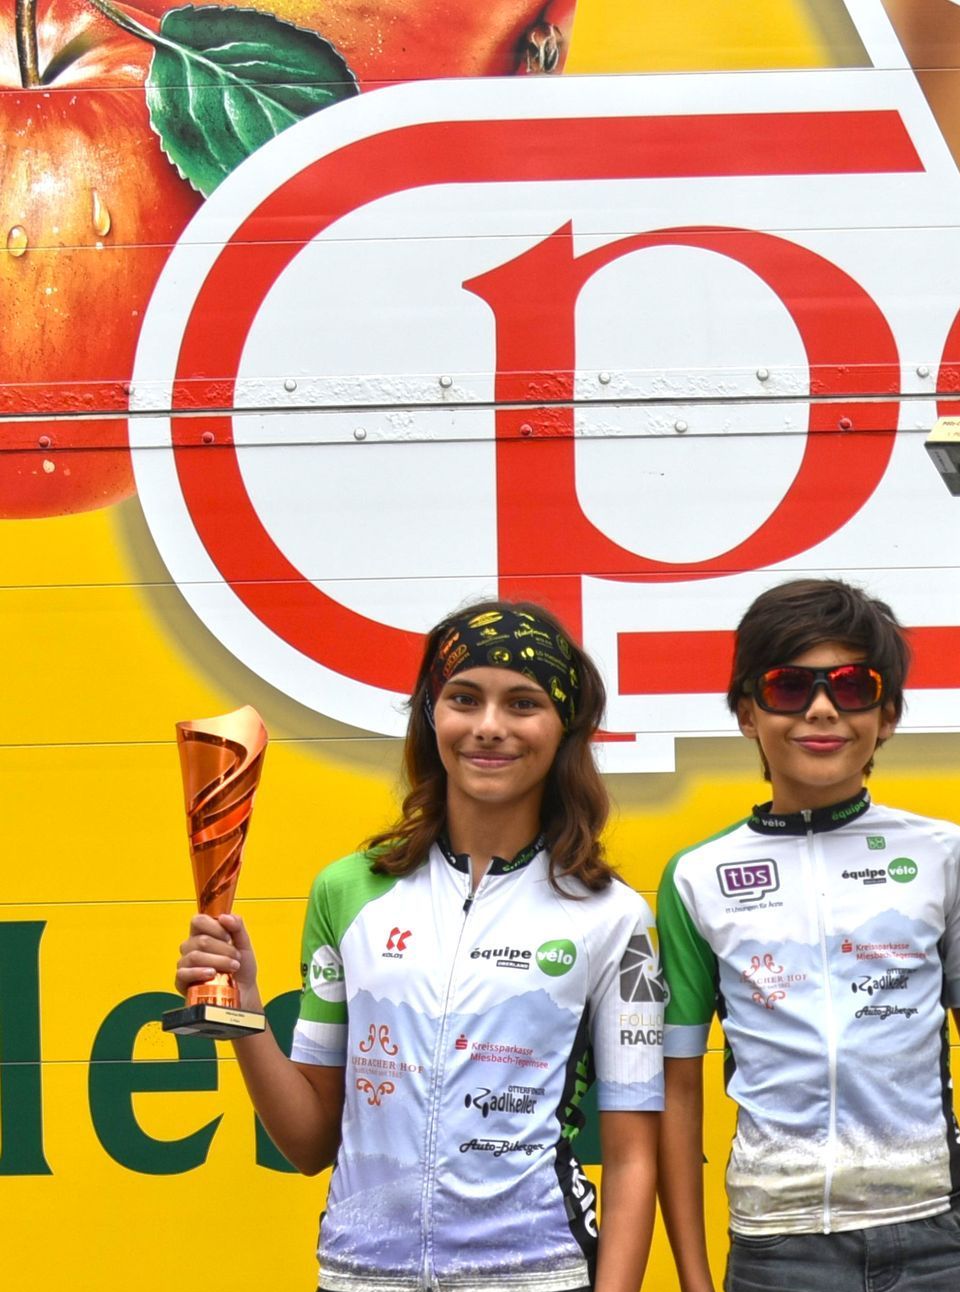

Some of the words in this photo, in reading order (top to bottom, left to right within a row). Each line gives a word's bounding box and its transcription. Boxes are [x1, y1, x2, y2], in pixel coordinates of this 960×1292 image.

[727, 866, 769, 888] tbs
[841, 868, 886, 880] équipe
[888, 865, 917, 876] vélo
[470, 946, 532, 960] équipe
[536, 947, 574, 966] vélo
[619, 1013, 664, 1028] FOLLO
[471, 1041, 534, 1056] Kreissparkasse
[458, 1138, 546, 1157] Auto-Biberger
